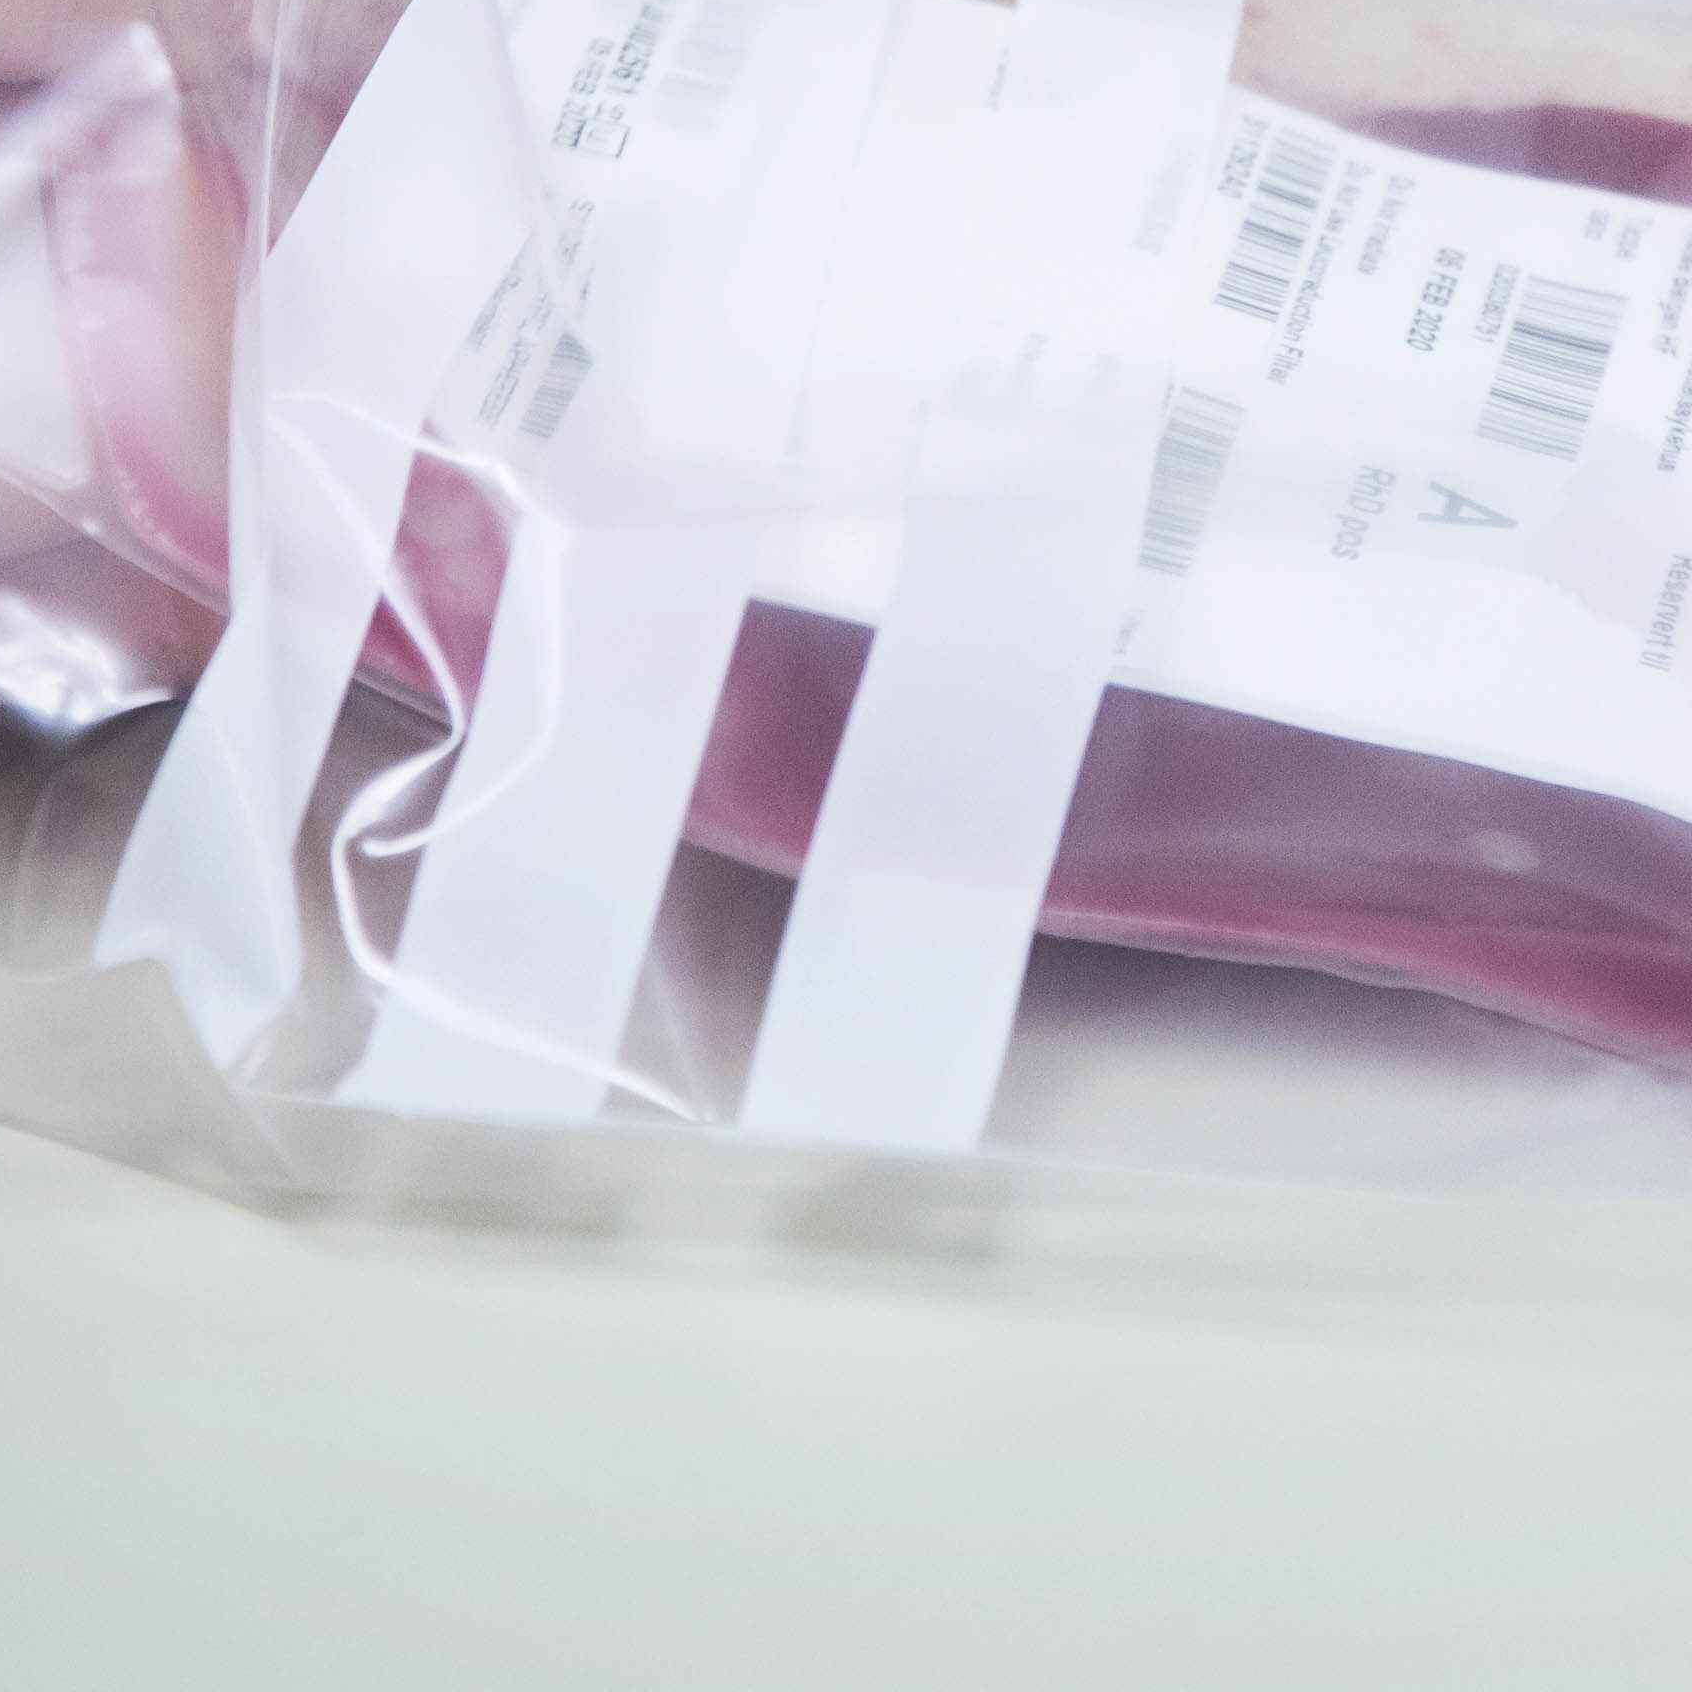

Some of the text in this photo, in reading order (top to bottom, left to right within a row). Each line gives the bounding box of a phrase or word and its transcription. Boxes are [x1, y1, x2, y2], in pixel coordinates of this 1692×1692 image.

[1422, 272, 1458, 307] FEB
[1406, 308, 1443, 351] 2020
[1268, 344, 1304, 385] Filter
[1331, 466, 1396, 560] RhD pos
[1417, 480, 1518, 529] A
